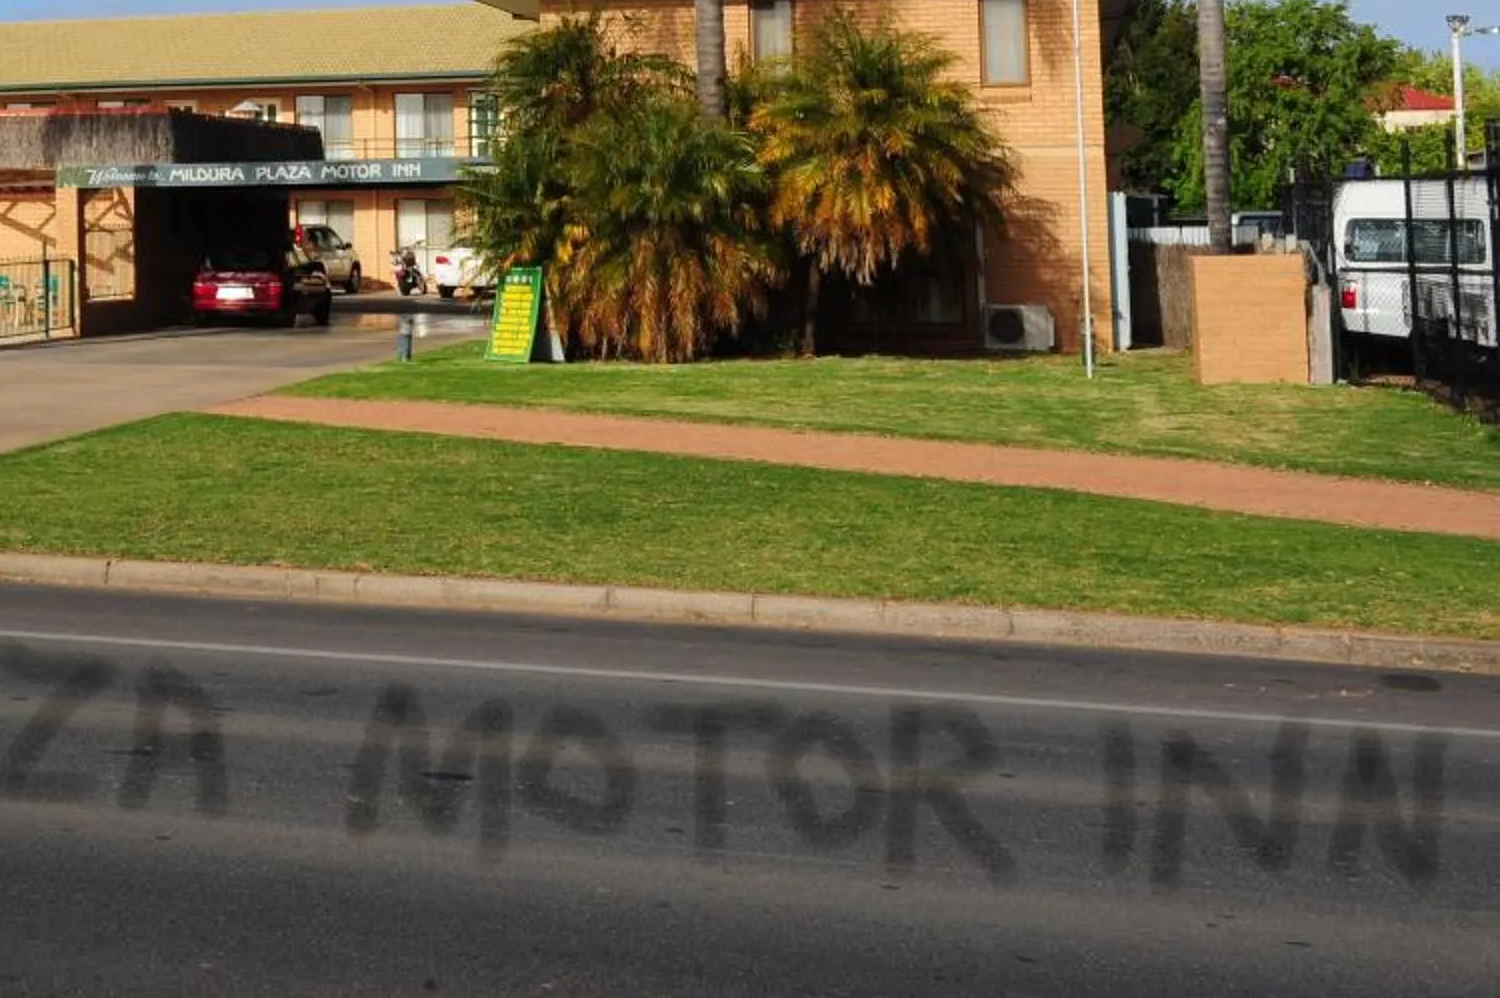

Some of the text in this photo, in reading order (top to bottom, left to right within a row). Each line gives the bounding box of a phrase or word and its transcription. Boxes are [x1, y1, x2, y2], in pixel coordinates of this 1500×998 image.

[169, 167, 244, 182] MILDURA
[256, 166, 311, 181] PLAZA
[321, 164, 382, 180] MOTOR
[392, 163, 421, 178] INN
